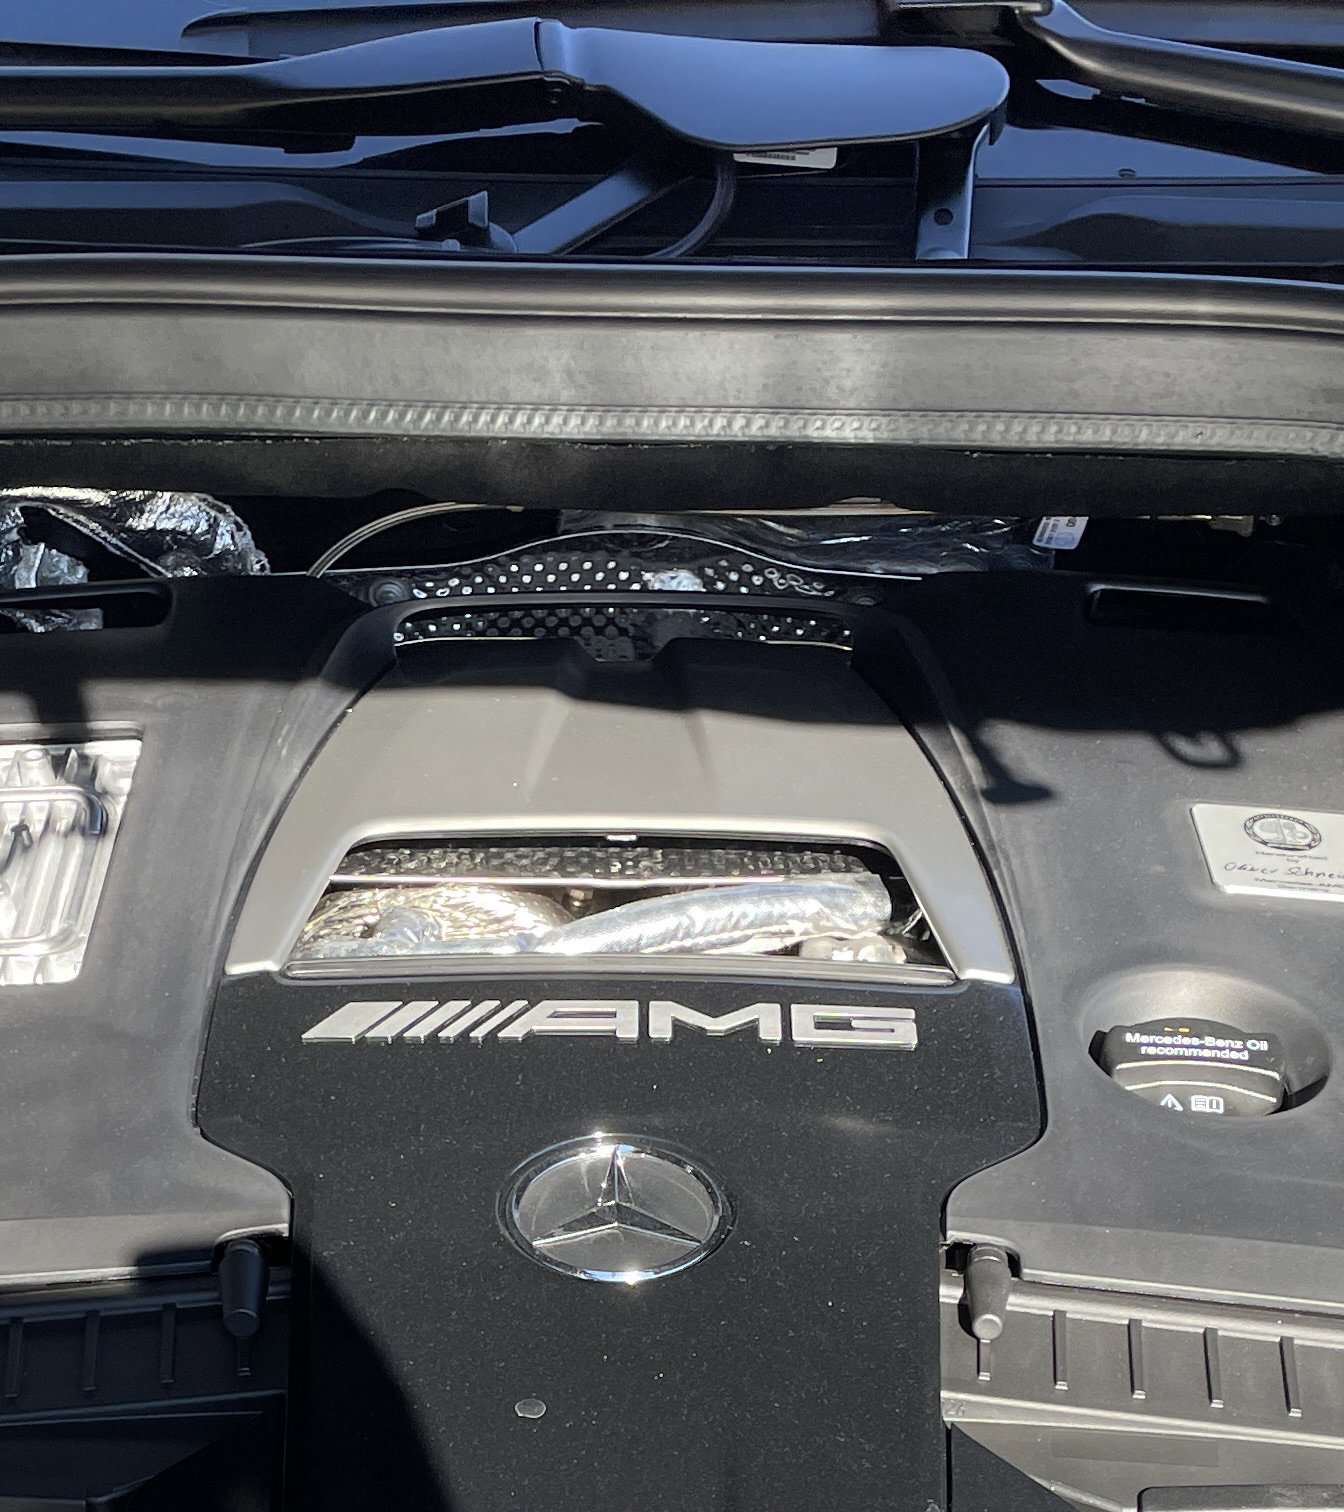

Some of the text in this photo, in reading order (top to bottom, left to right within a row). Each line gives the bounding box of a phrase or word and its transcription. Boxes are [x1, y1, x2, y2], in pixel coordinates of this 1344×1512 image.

[1125, 1032, 1268, 1051] Mercedes-Benz Oil
[1141, 1046, 1248, 1060] recommended
